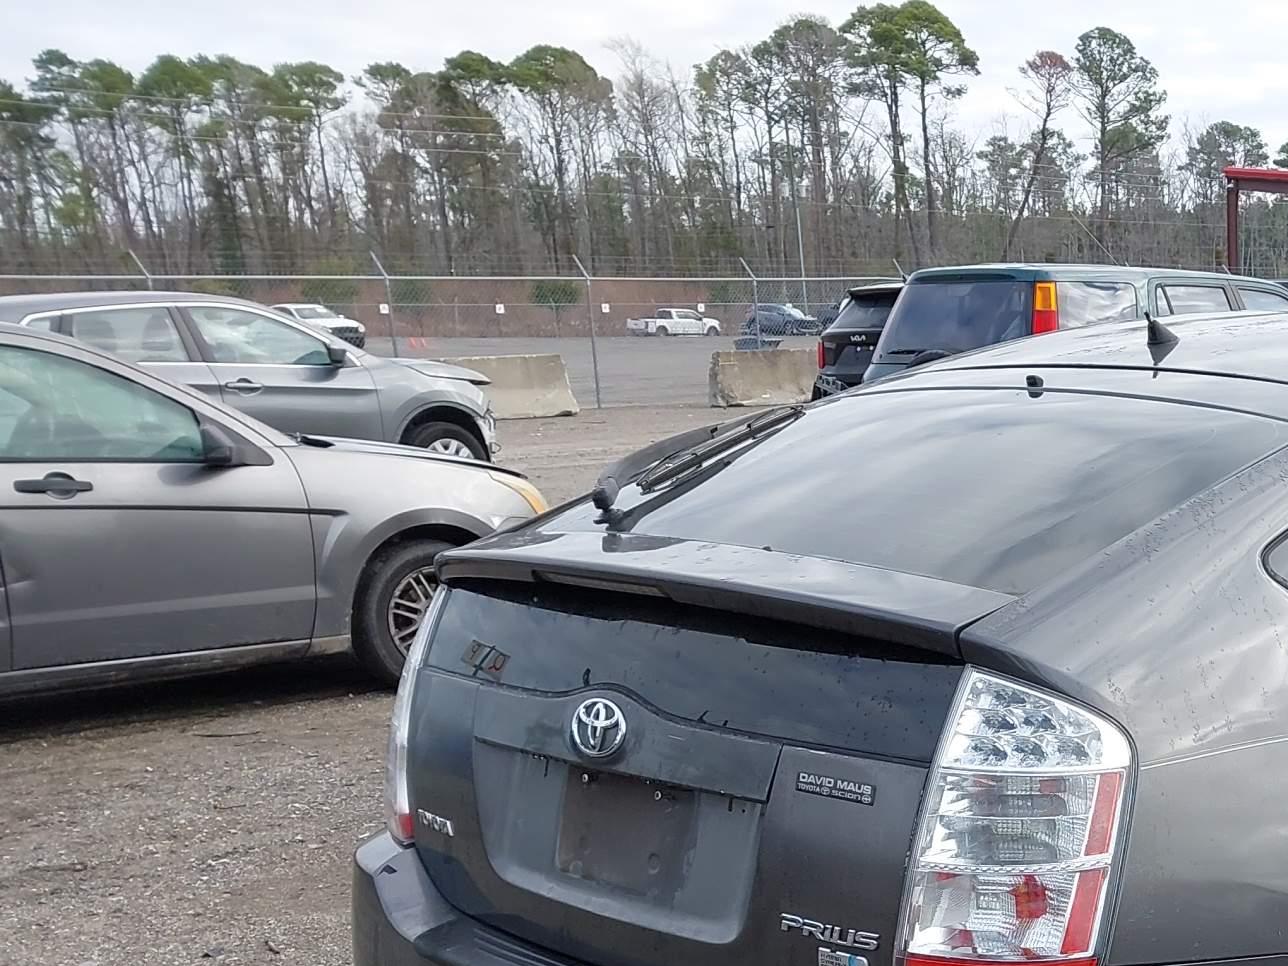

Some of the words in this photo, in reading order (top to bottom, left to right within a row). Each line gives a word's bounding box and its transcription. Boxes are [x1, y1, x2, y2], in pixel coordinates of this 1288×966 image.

[797, 782, 821, 793] TOYOTA
[799, 772, 834, 788] DAVID
[836, 780, 872, 795] MAUS
[780, 912, 880, 951] PRIUS
